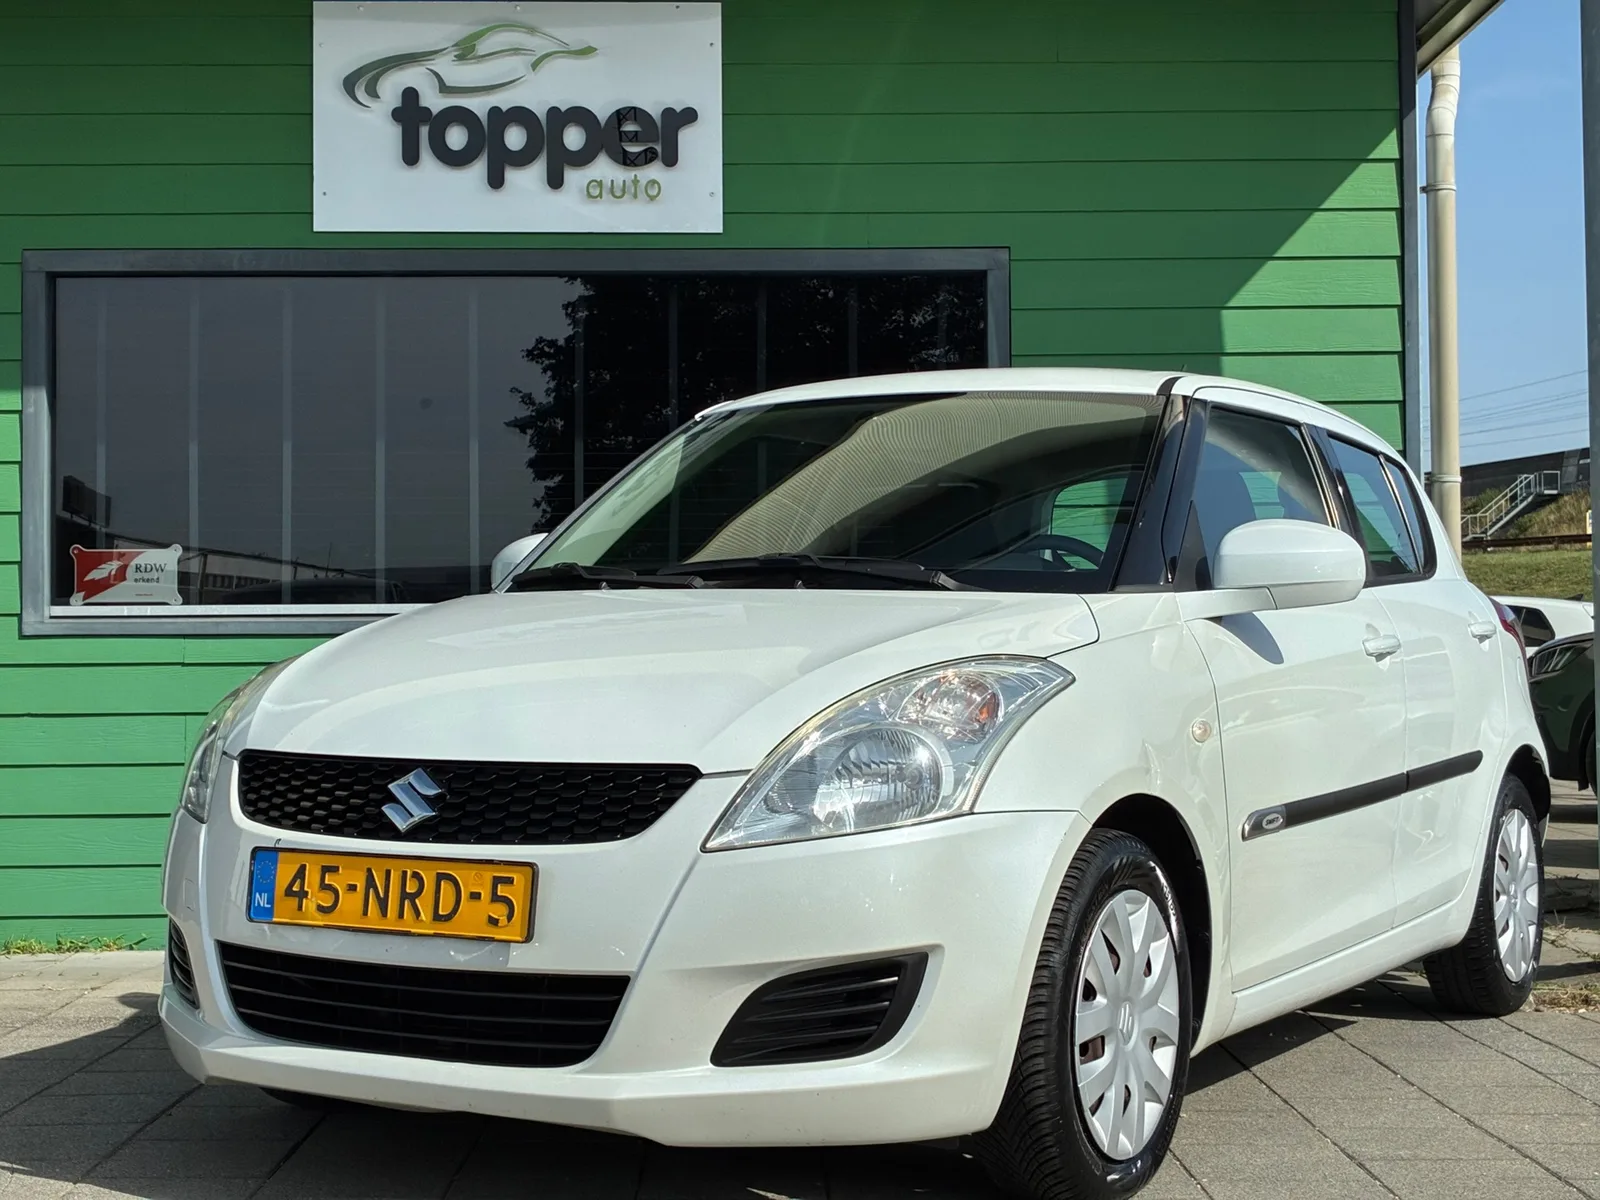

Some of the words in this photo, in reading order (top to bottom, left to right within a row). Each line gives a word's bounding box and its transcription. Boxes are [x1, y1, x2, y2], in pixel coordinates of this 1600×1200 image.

[391, 87, 698, 190] topper
[586, 174, 662, 201] auto
[134, 563, 167, 573] RDW
[255, 892, 271, 907] NL
[284, 863, 516, 927] 45-NRD-5
